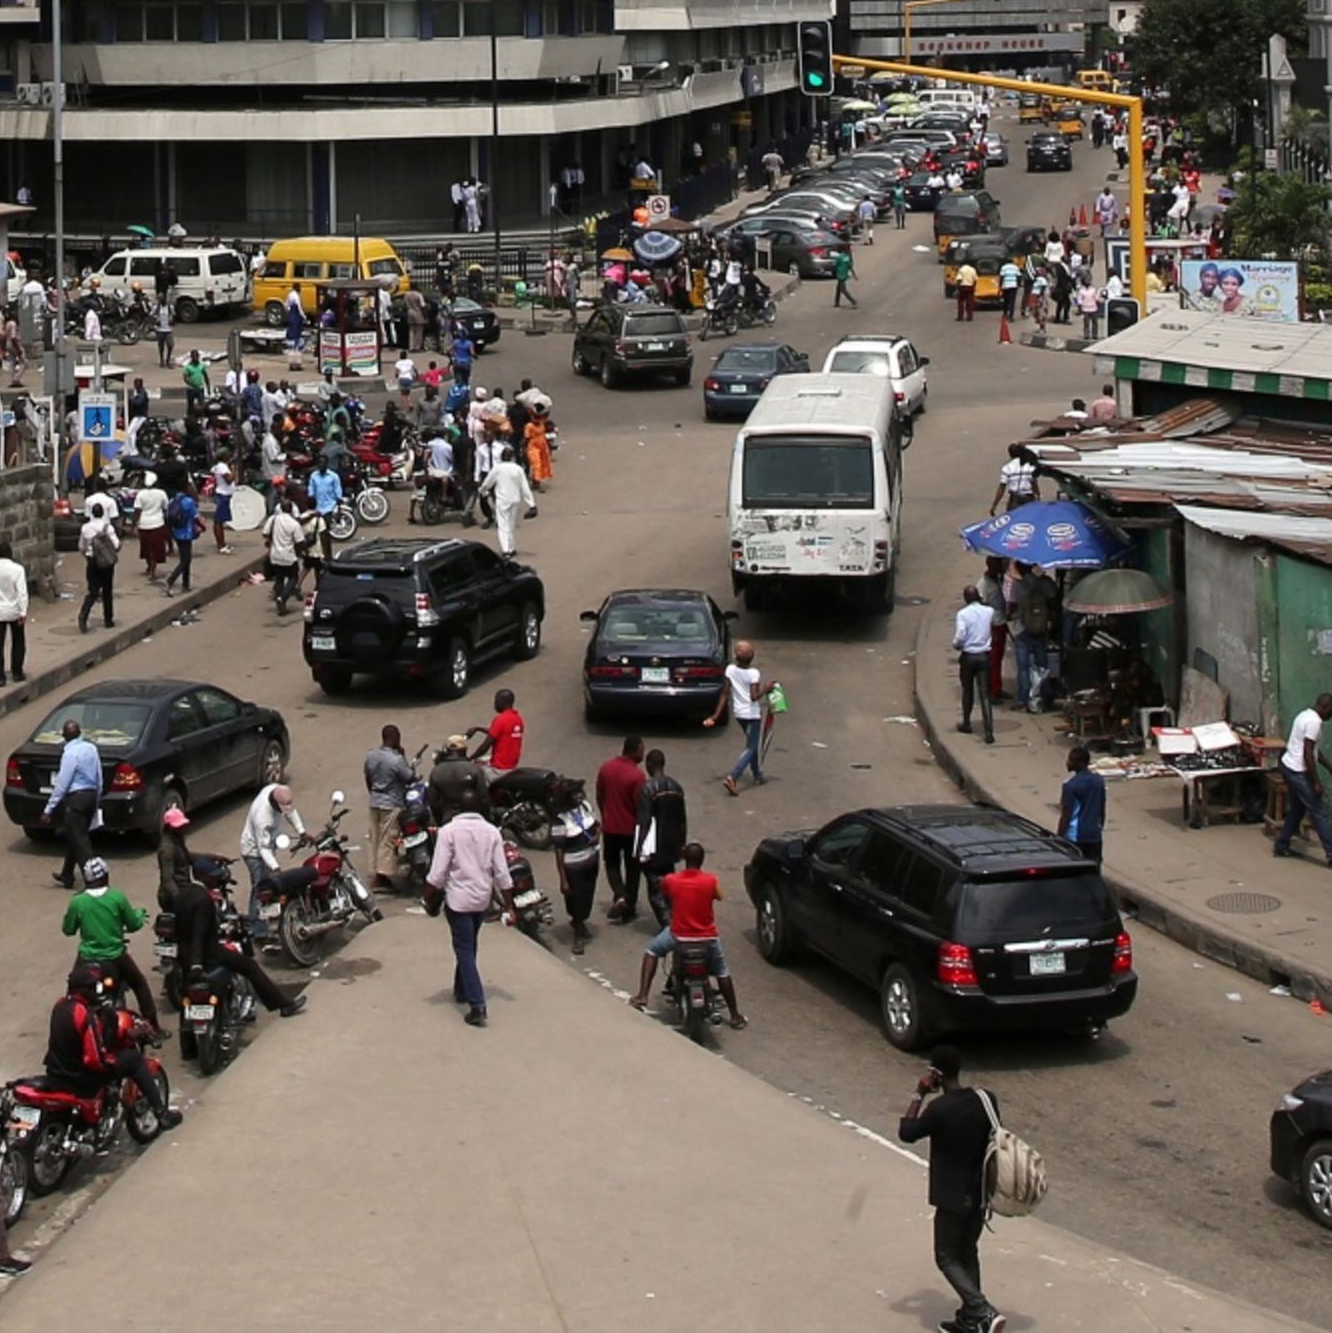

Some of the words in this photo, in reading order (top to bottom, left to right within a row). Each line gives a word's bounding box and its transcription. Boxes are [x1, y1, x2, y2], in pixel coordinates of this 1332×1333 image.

[918, 41, 990, 51] BOOKSHOP
[1002, 39, 1044, 49] HOUSE
[1241, 264, 1293, 273] Marriage
